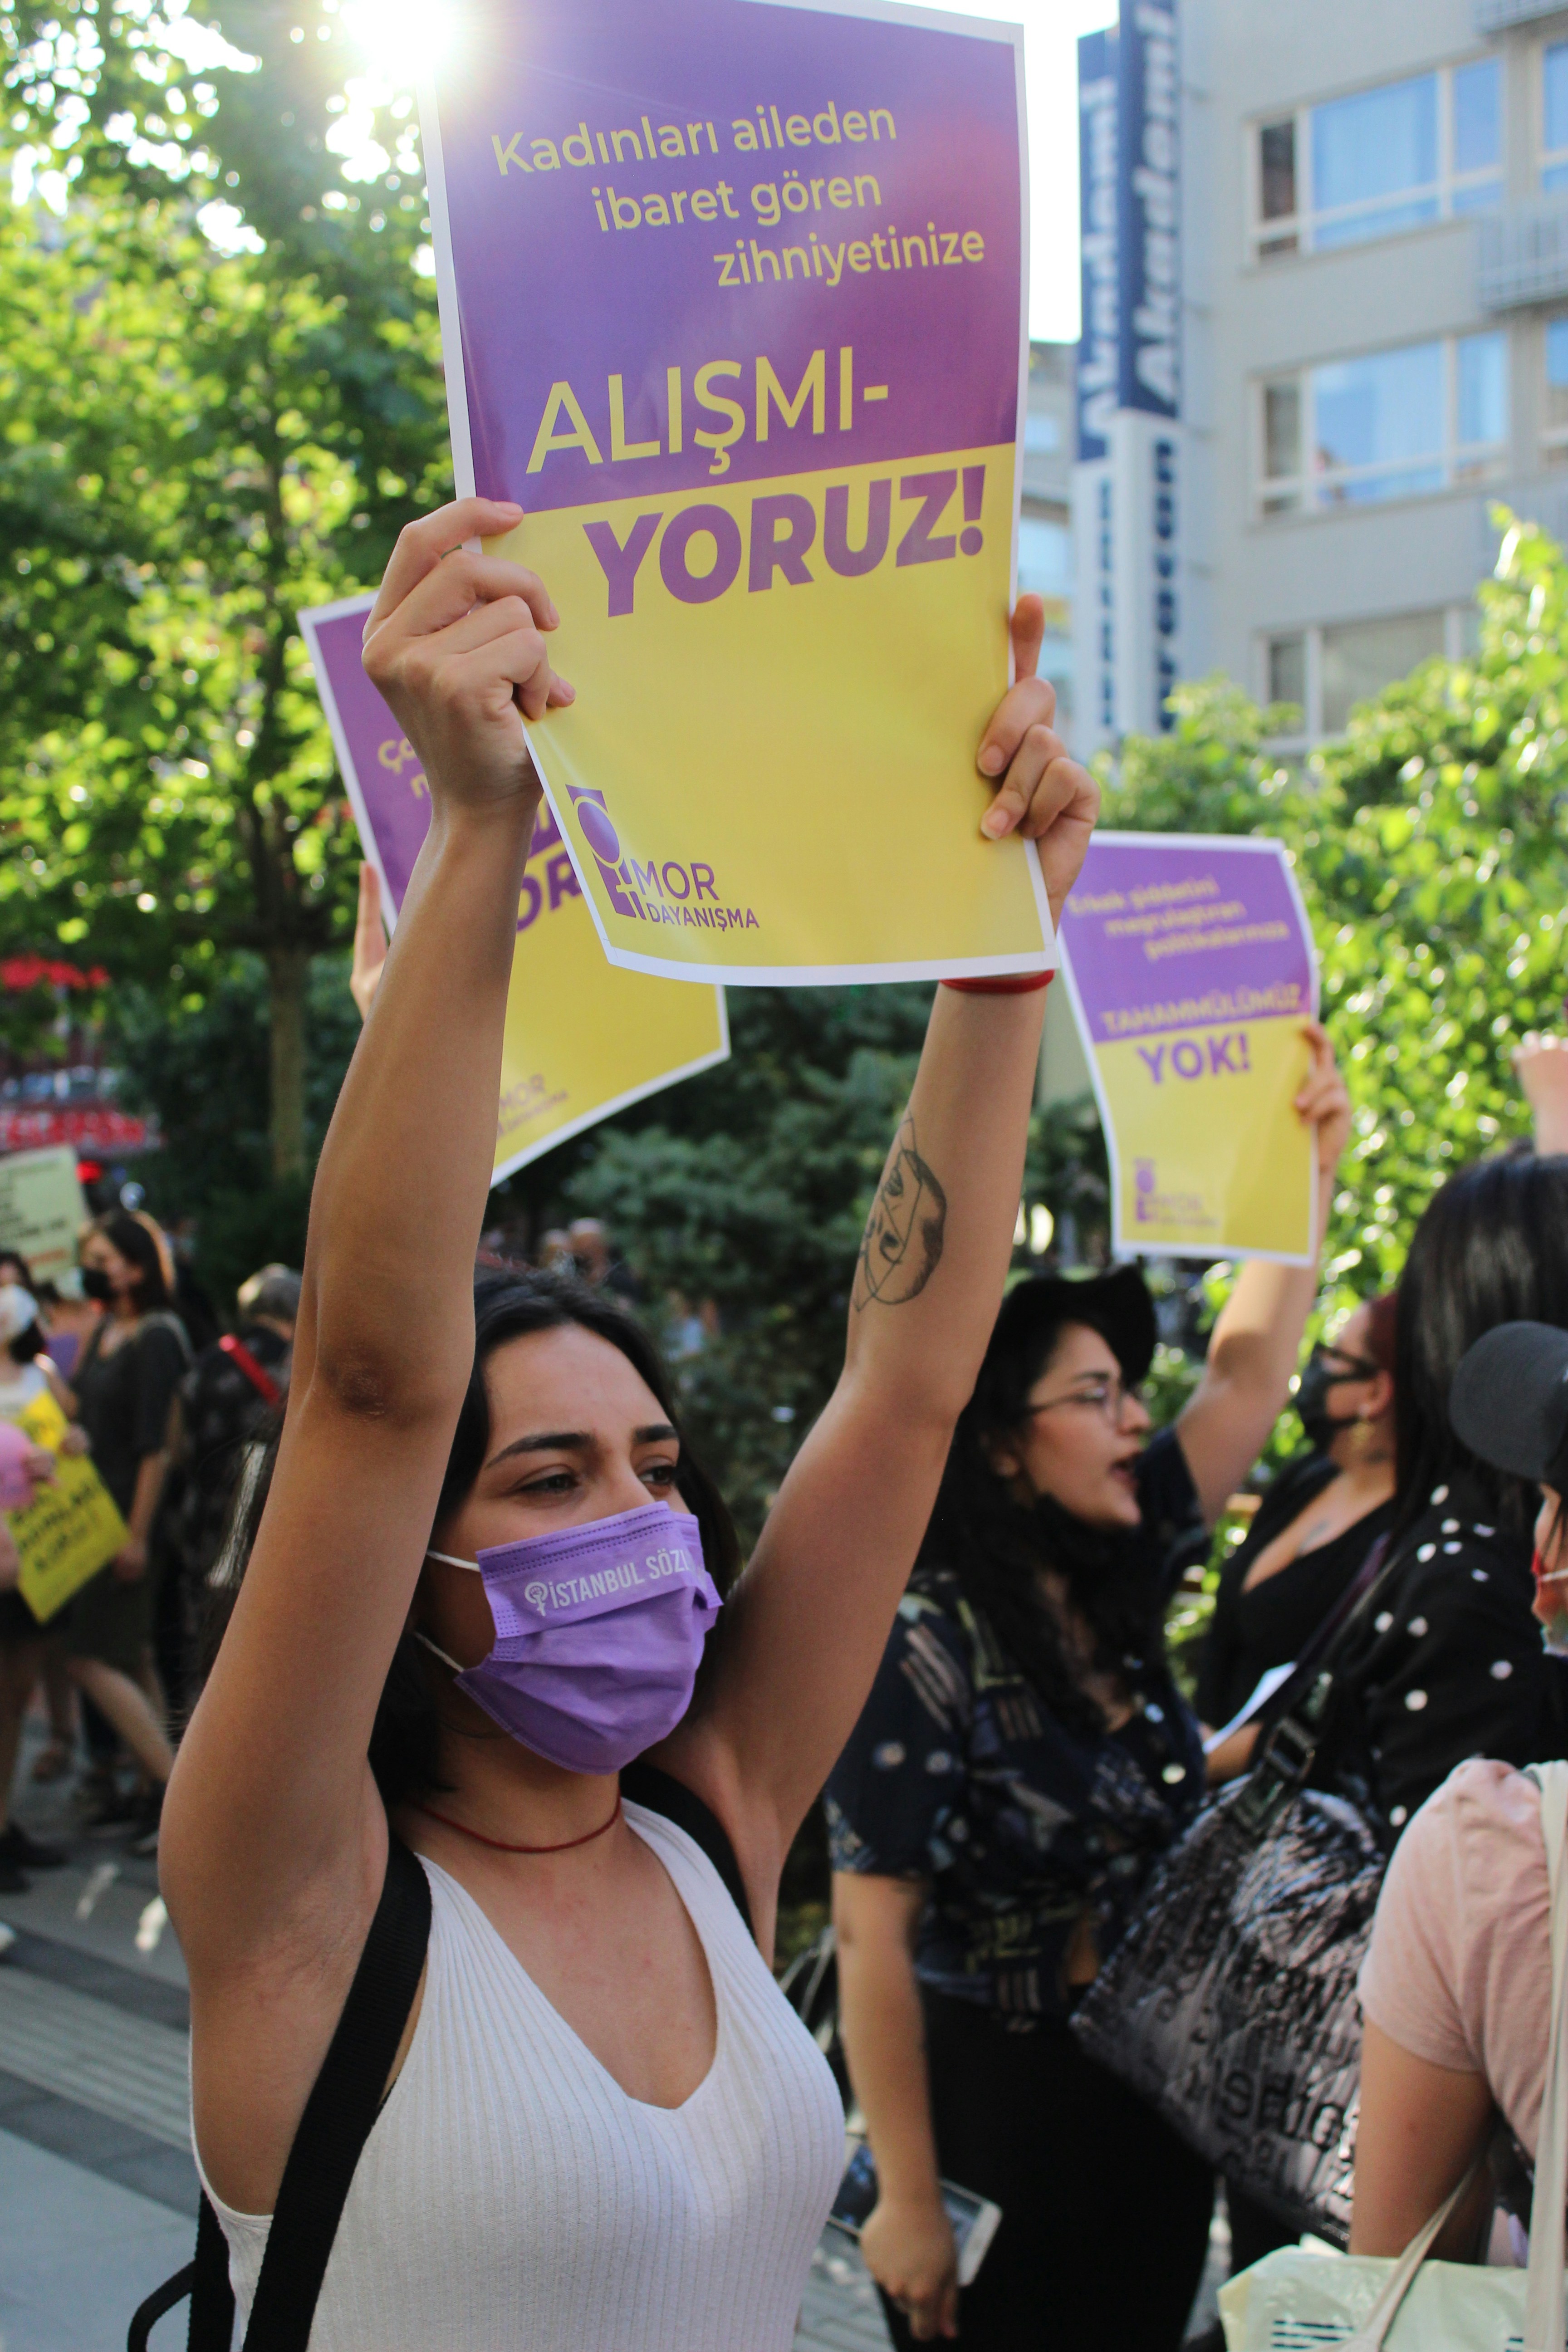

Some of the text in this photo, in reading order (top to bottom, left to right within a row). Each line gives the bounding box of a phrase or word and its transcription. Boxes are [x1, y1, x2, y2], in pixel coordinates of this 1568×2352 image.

[491, 101, 897, 176] Kadınları aileden
[591, 170, 882, 231] ibaret gören
[713, 222, 985, 286] zihniyetinize
[525, 346, 888, 475] ALIŞMI-
[583, 464, 986, 617] YORUZ!
[630, 859, 720, 900] MOR
[646, 902, 760, 932] DAYANIŞMA
[1137, 1033, 1251, 1084] YOK!
[548, 1562, 645, 1609] İSTANBUL
